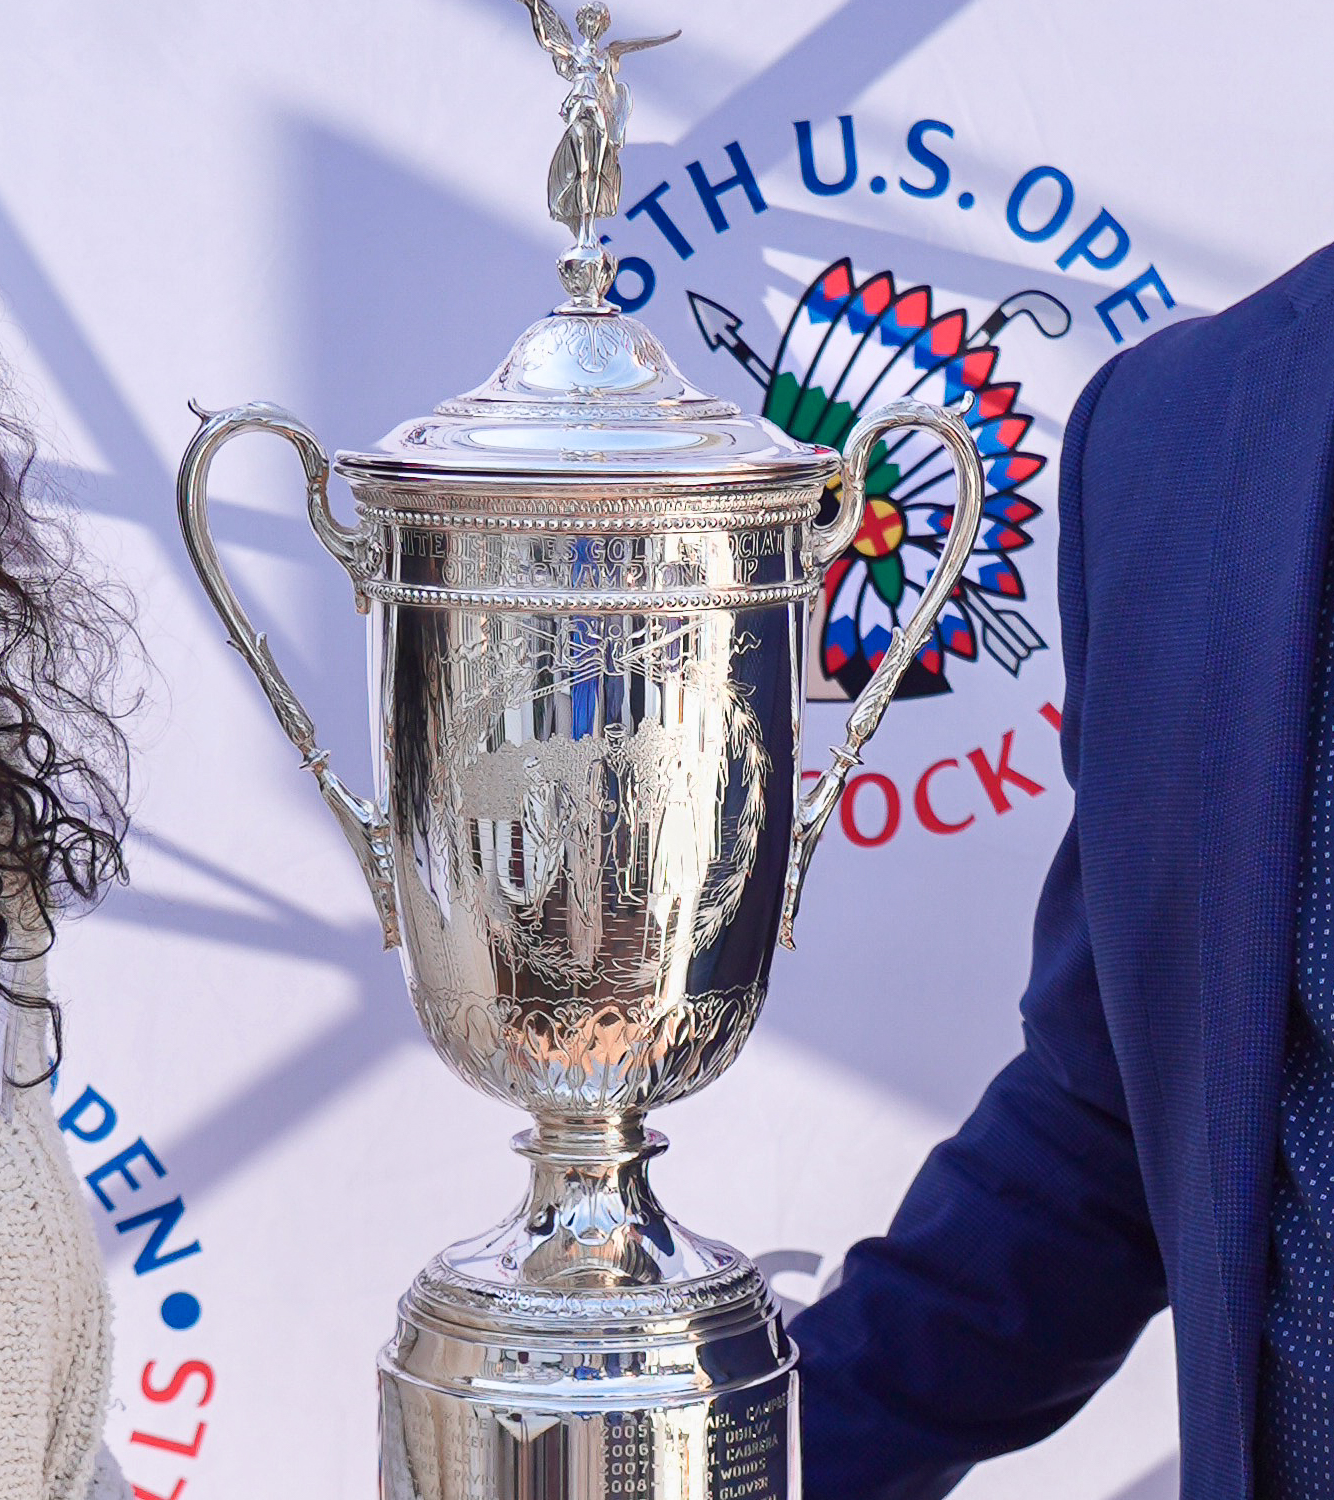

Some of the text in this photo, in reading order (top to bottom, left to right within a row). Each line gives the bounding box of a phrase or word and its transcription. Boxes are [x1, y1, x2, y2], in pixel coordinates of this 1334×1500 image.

[600, 114, 1180, 344] 6TH U.S. OPE
[50, 1056, 202, 1277] PEN
